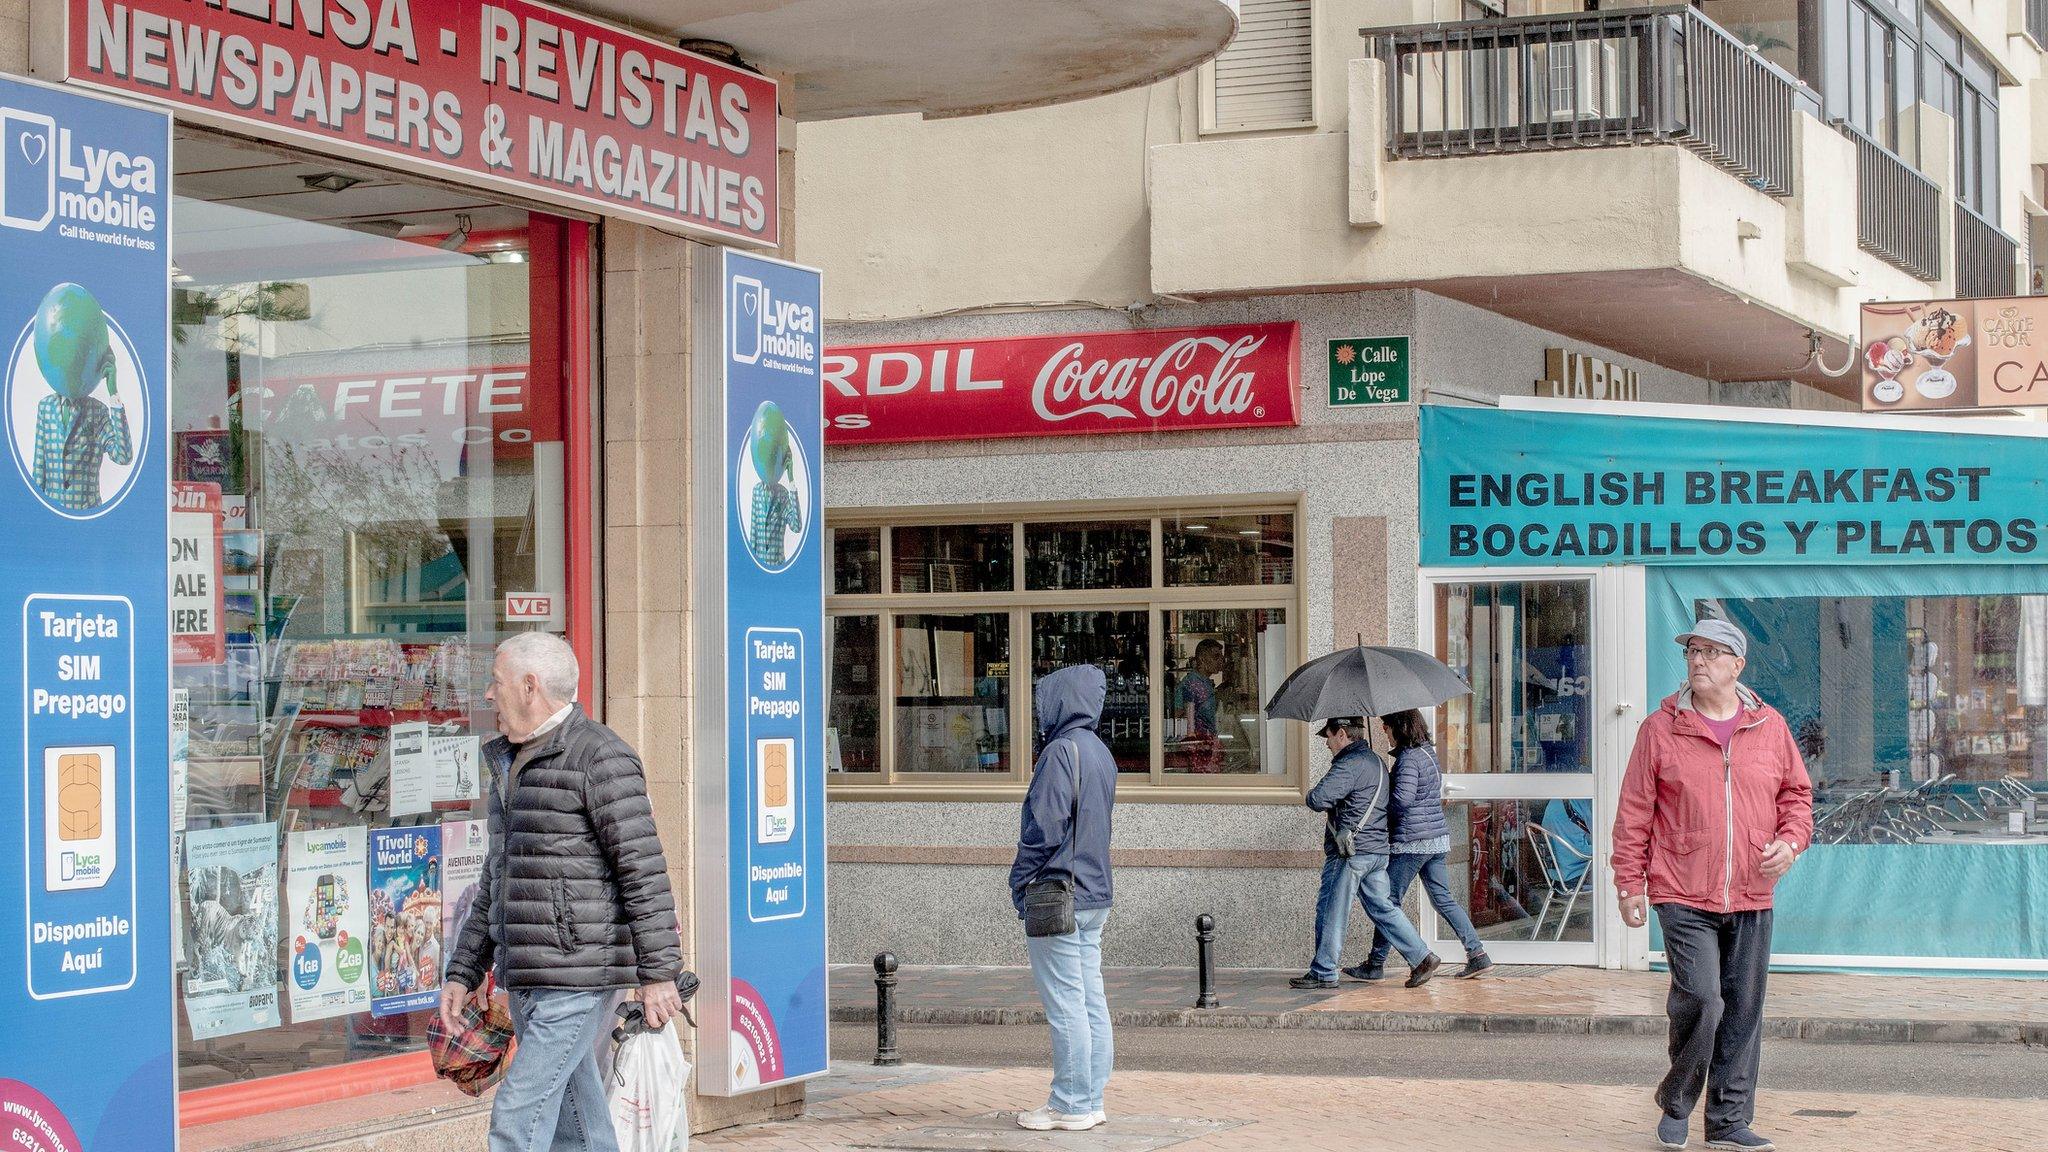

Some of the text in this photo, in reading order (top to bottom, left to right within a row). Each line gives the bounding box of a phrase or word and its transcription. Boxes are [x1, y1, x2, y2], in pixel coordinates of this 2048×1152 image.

[481, 3, 750, 156] REVISTAS
[87, 0, 766, 233] NEWSPAPERS & MAGAZINES
[59, 128, 156, 194] Lyca
[59, 191, 156, 231] mobile
[59, 224, 156, 251] Call the world for less
[763, 288, 814, 335] Lyca
[1981, 318, 2034, 333] CARTE
[763, 332, 814, 361] mobile
[1361, 346, 1398, 364] Calle
[1031, 334, 1267, 421] Coca-Cola
[1350, 369, 1386, 386] Lope
[1994, 361, 2048, 393] CA
[1337, 386, 1399, 404] De Vega
[1449, 467, 1991, 507] ENGLISH BREAKFAST
[1449, 517, 2038, 557] BOCADILLOS Y PLATOS
[173, 574, 207, 597] ALE
[512, 599, 548, 614] VG
[40, 611, 118, 643] Tarjeta
[172, 609, 208, 633] ERE
[754, 640, 796, 663] Tarjeta
[58, 654, 101, 681] SIM
[763, 671, 787, 691] SIM
[33, 688, 126, 719] Prepago
[751, 696, 800, 719] Prepago
[306, 839, 347, 853] Lycamobile
[377, 833, 412, 850] Tivoli
[75, 853, 101, 867] Lyca
[377, 849, 412, 865] World
[75, 865, 101, 876] mobile
[751, 862, 803, 883] Disponible
[765, 885, 789, 905] Aquí
[33, 915, 130, 945] Disponible
[61, 948, 104, 975] Aquí
[3, 1101, 71, 1152] www.lycamo
